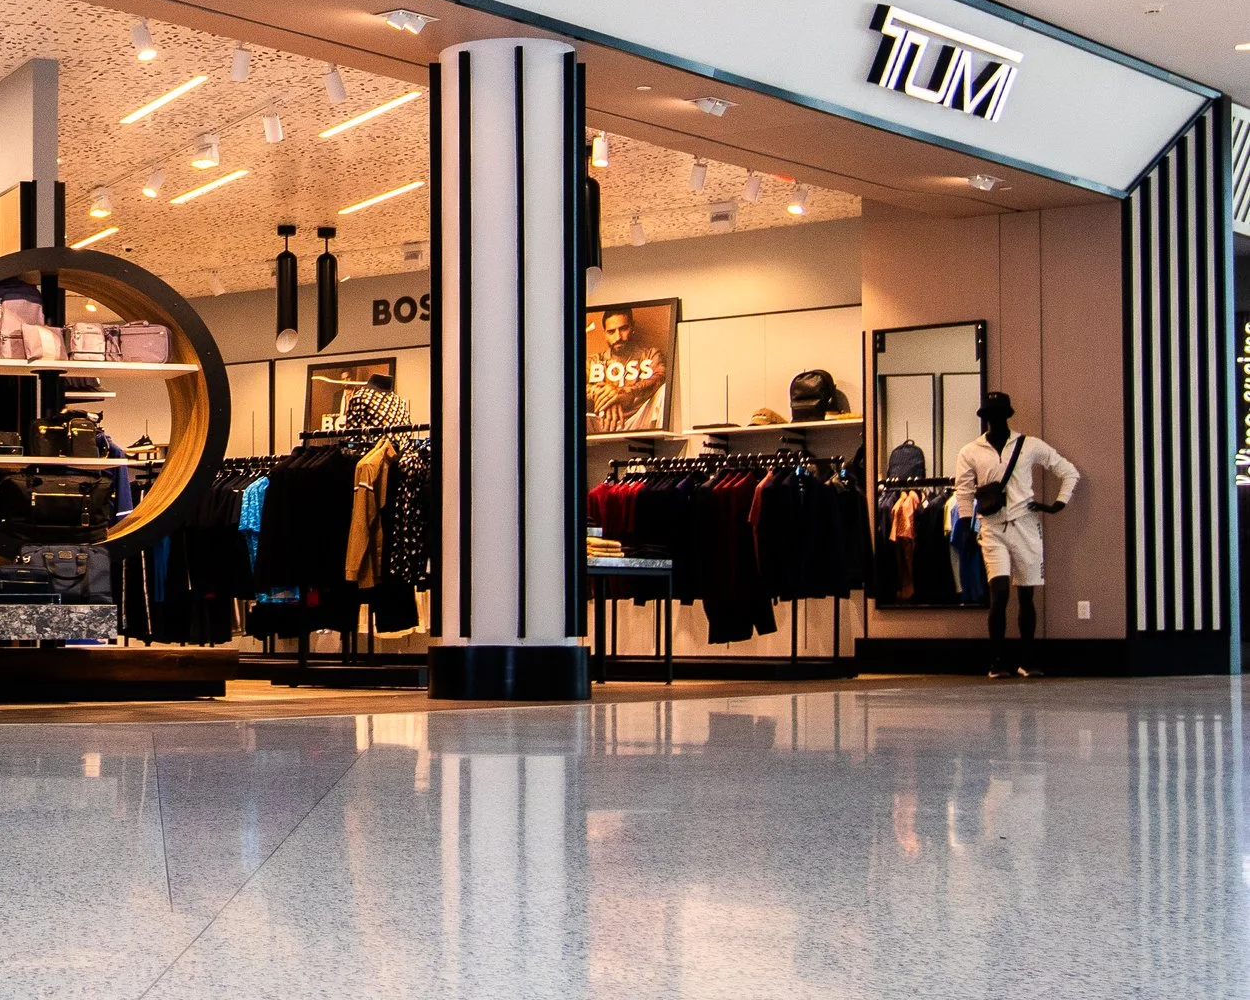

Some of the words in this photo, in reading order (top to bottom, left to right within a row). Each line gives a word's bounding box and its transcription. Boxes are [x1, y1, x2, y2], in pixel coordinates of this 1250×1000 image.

[870, 4, 1024, 123] TUMI
[372, 293, 431, 326] BOS
[588, 359, 654, 383] BOSS
